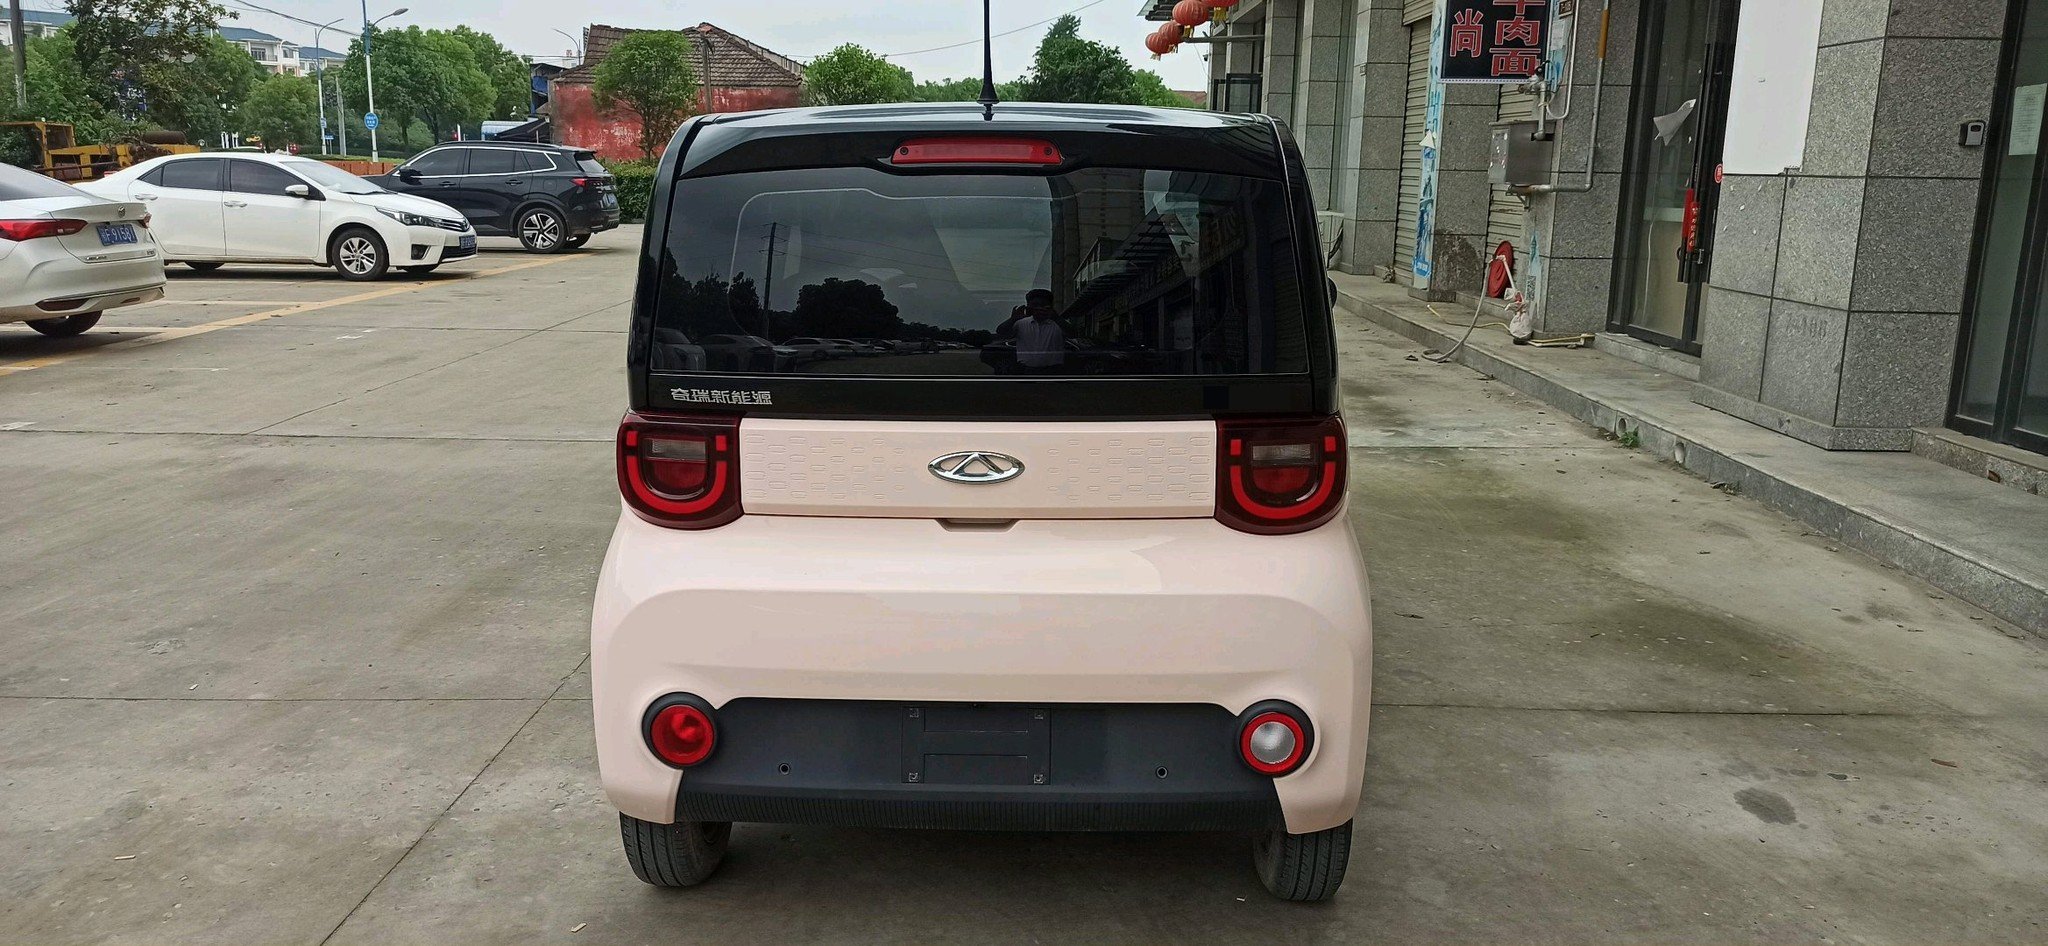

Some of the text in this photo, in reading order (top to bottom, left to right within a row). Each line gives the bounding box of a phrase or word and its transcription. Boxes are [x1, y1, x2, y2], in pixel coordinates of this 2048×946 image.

[1450, 8, 1484, 58] 尚
[670, 387, 773, 405] 奇瑞新能源
